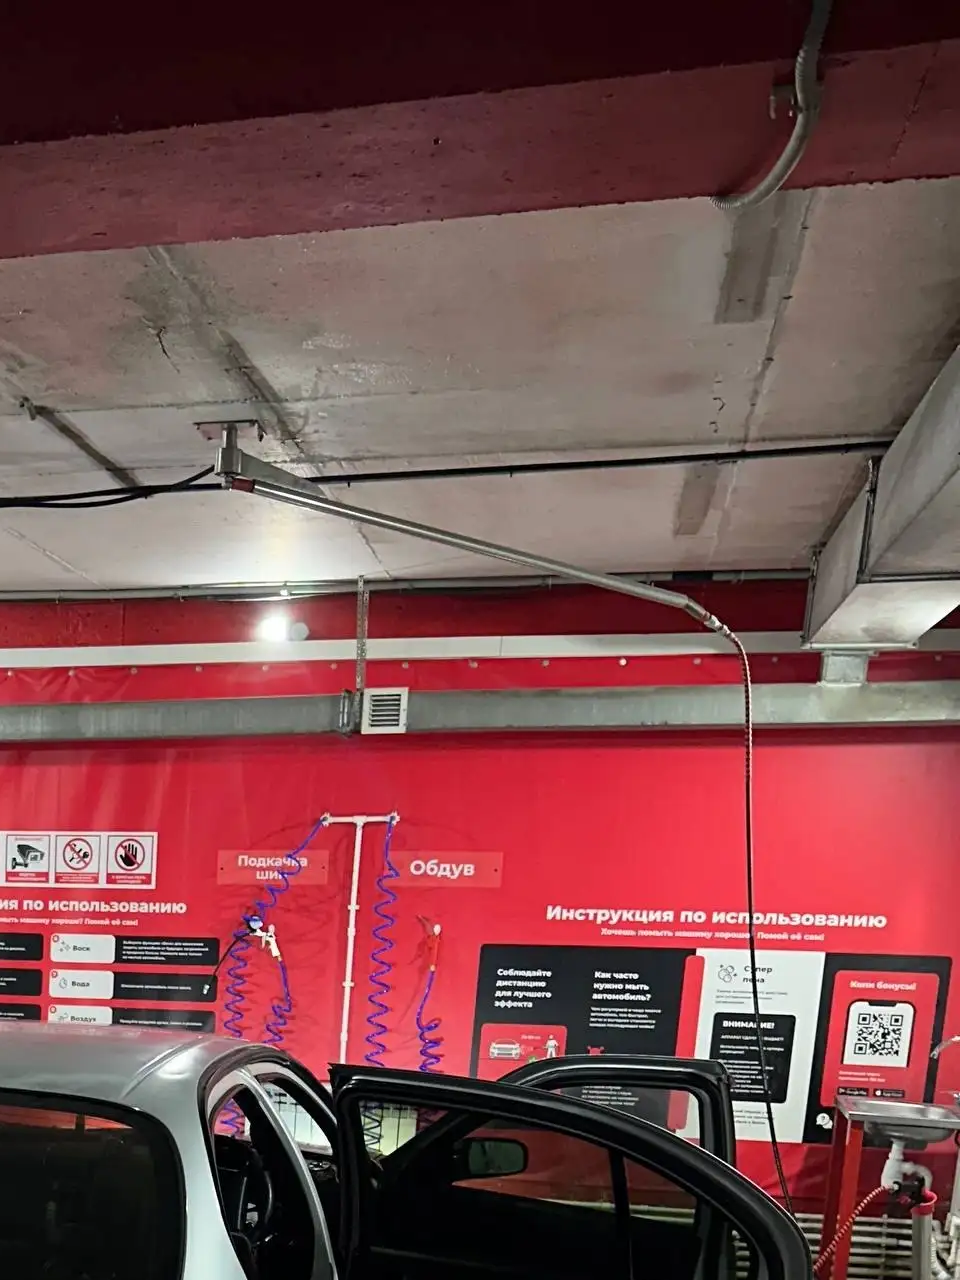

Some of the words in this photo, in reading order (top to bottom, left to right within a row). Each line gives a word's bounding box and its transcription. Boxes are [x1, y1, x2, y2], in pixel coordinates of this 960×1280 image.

[238, 855, 308, 868] Подкачка
[409, 860, 475, 878] Обдув
[23, 900, 44, 911] по
[48, 900, 188, 914] использованию
[546, 905, 674, 924] Инструкция
[680, 911, 706, 923] по
[712, 912, 887, 928] использованию
[714, 931, 752, 940] хорошо
[497, 968, 552, 978] Соблюдайте
[743, 965, 773, 974] Спер
[594, 970, 612, 980] Как
[612, 972, 640, 981] часто
[495, 979, 547, 988] дистанцию
[593, 982, 624, 992] нужно
[624, 983, 650, 992] мыть
[494, 989, 512, 999] для
[513, 990, 553, 1000] лучшего
[591, 992, 652, 1002] автомобиль?
[494, 1000, 533, 1010] эффекта
